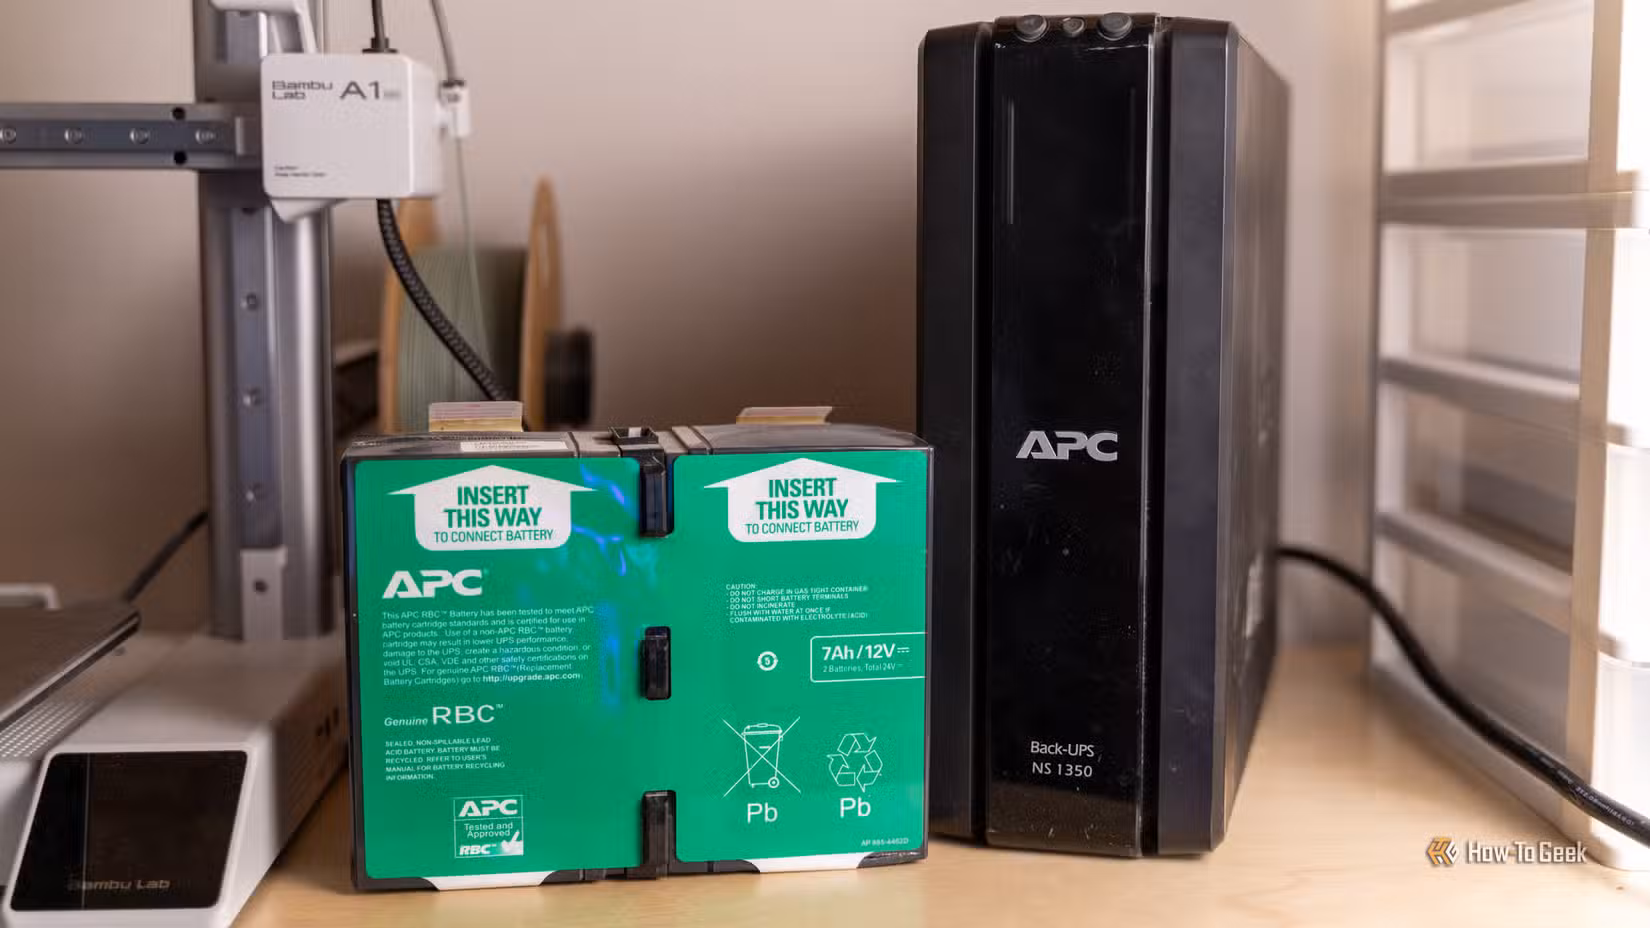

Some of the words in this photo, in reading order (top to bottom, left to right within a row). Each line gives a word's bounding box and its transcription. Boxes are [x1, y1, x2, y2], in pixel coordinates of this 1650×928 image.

[272, 80, 333, 90] Bambu
[339, 80, 379, 100] A1
[272, 91, 306, 100] Lab
[1016, 431, 1118, 462] APC
[768, 478, 837, 498] INSERT
[457, 485, 529, 506] INSERT
[755, 501, 799, 520] THIS
[803, 499, 848, 519] WAY
[443, 508, 490, 528] THIS
[494, 507, 542, 527] WAY
[745, 523, 759, 535] TO
[762, 522, 812, 534] CONNECT
[814, 520, 859, 532] BATTERY
[434, 532, 449, 543] TO
[451, 530, 504, 543] CONNECT
[507, 529, 553, 542] BATTERY
[382, 569, 483, 599] APC
[382, 611, 400, 619] This
[401, 610, 419, 619] APC
[450, 610, 479, 619] Battery
[576, 606, 594, 614] APC
[412, 620, 448, 629] cartridge
[516, 617, 548, 625] certified
[550, 616, 560, 624] for
[730, 616, 781, 624] CONTAMINATED
[383, 630, 401, 639] APC
[444, 629, 460, 637] Use
[480, 627, 516, 636] non-APC
[383, 640, 418, 649] cartridge
[420, 640, 437, 648] may
[439, 638, 461, 646] result
[496, 637, 514, 645] UPS
[383, 651, 416, 659] damage
[465, 647, 490, 655] create
[500, 646, 541, 654] hazardous
[384, 659, 400, 667] void
[441, 656, 459, 665] VDE
[462, 656, 477, 664] and
[478, 656, 500, 664] other
[502, 655, 525, 664] safety
[527, 654, 577, 662] certifications
[865, 663, 882, 671] Total
[883, 662, 896, 670] 24V
[384, 668, 396, 676] the
[421, 667, 435, 675] For
[437, 668, 469, 676] genuine
[470, 665, 489, 674] APC
[384, 678, 413, 686] Battery
[414, 676, 459, 686] Cartridges)
[384, 716, 428, 727] Genuine
[1030, 740, 1094, 757] Back-UPS
[432, 763, 464, 771] BATTERY
[465, 761, 505, 769] RECYCLING
[1032, 761, 1051, 776] NS
[1057, 763, 1093, 778] 1350
[458, 800, 518, 817] APC
[747, 802, 778, 823] Pb
[840, 797, 871, 818] Pb
[464, 823, 493, 831] Tested
[467, 830, 510, 839] Approved
[136, 879, 170, 890] Lab
